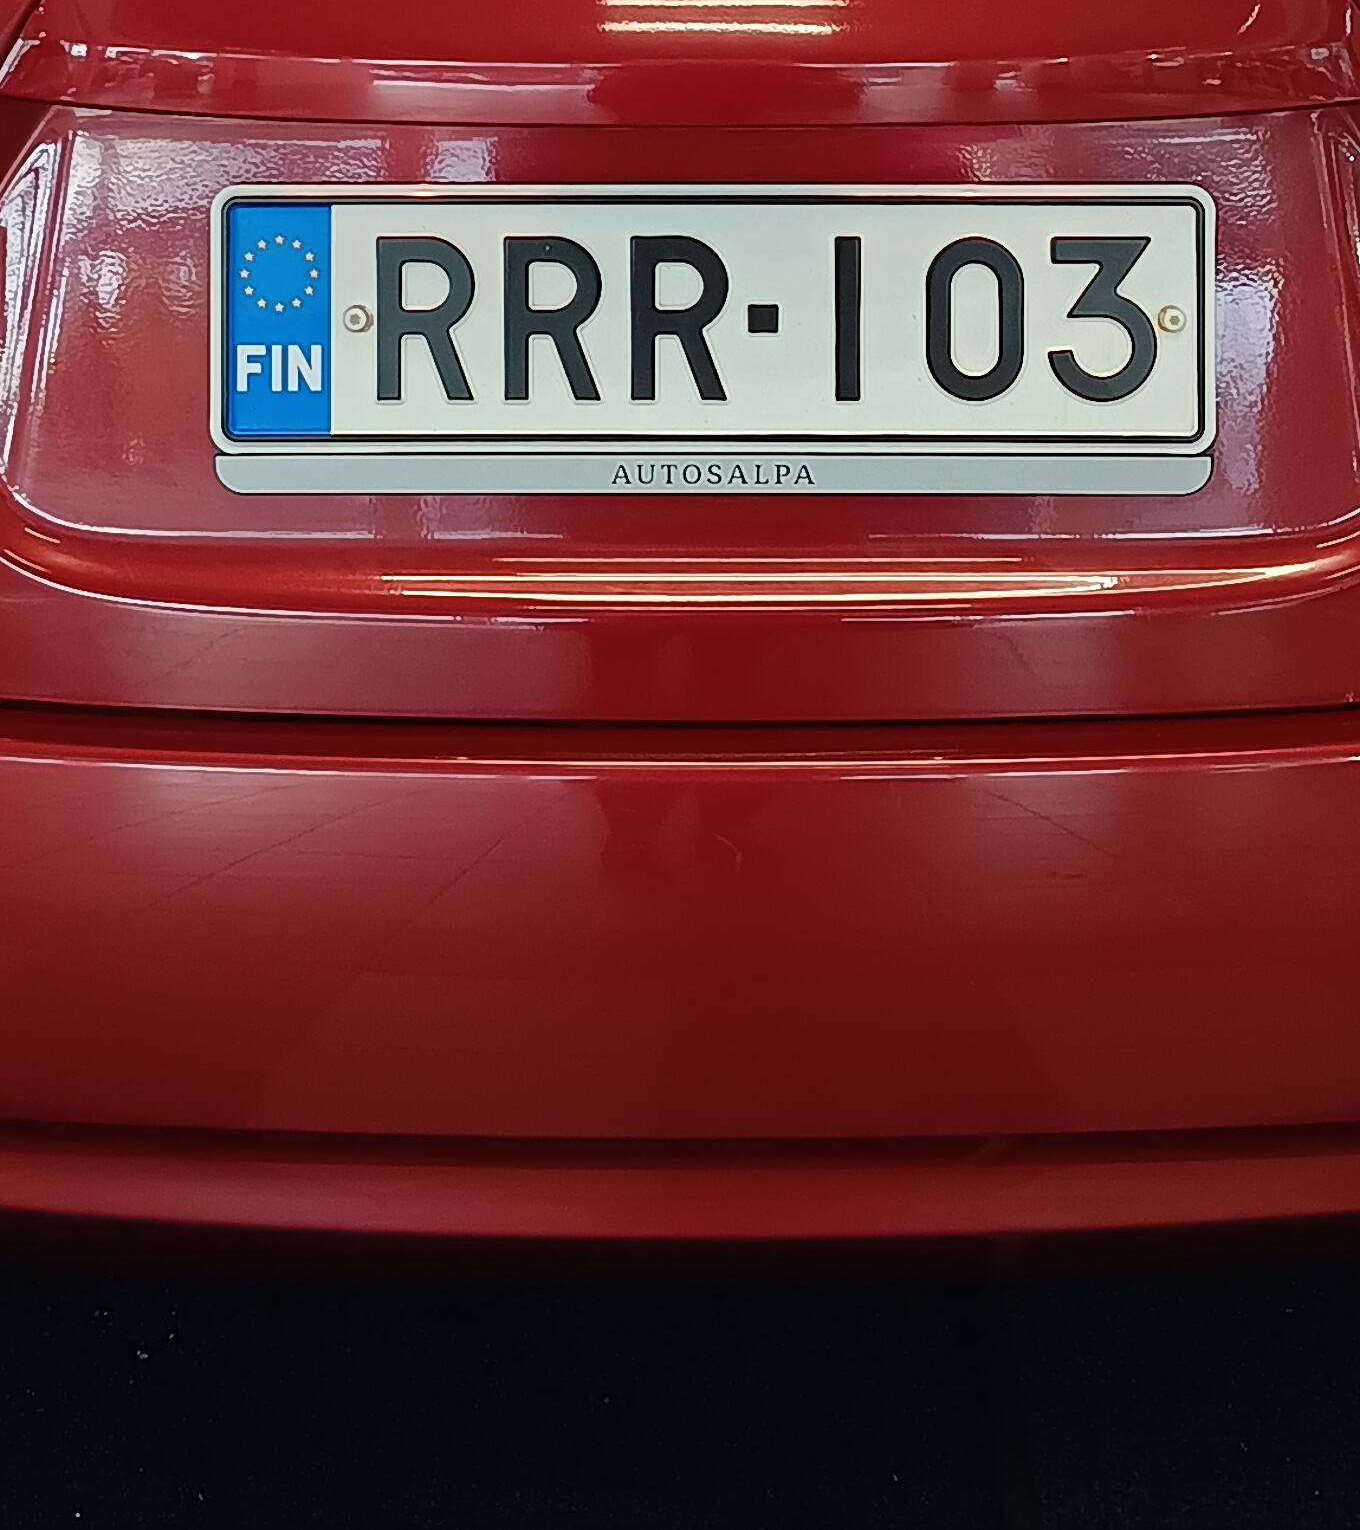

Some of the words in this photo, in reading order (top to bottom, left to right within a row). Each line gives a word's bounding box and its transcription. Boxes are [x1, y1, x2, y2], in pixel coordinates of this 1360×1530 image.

[375, 234, 1158, 403] RRR-103
[234, 344, 324, 393] FIN
[611, 463, 816, 485] AUTOSALPA
